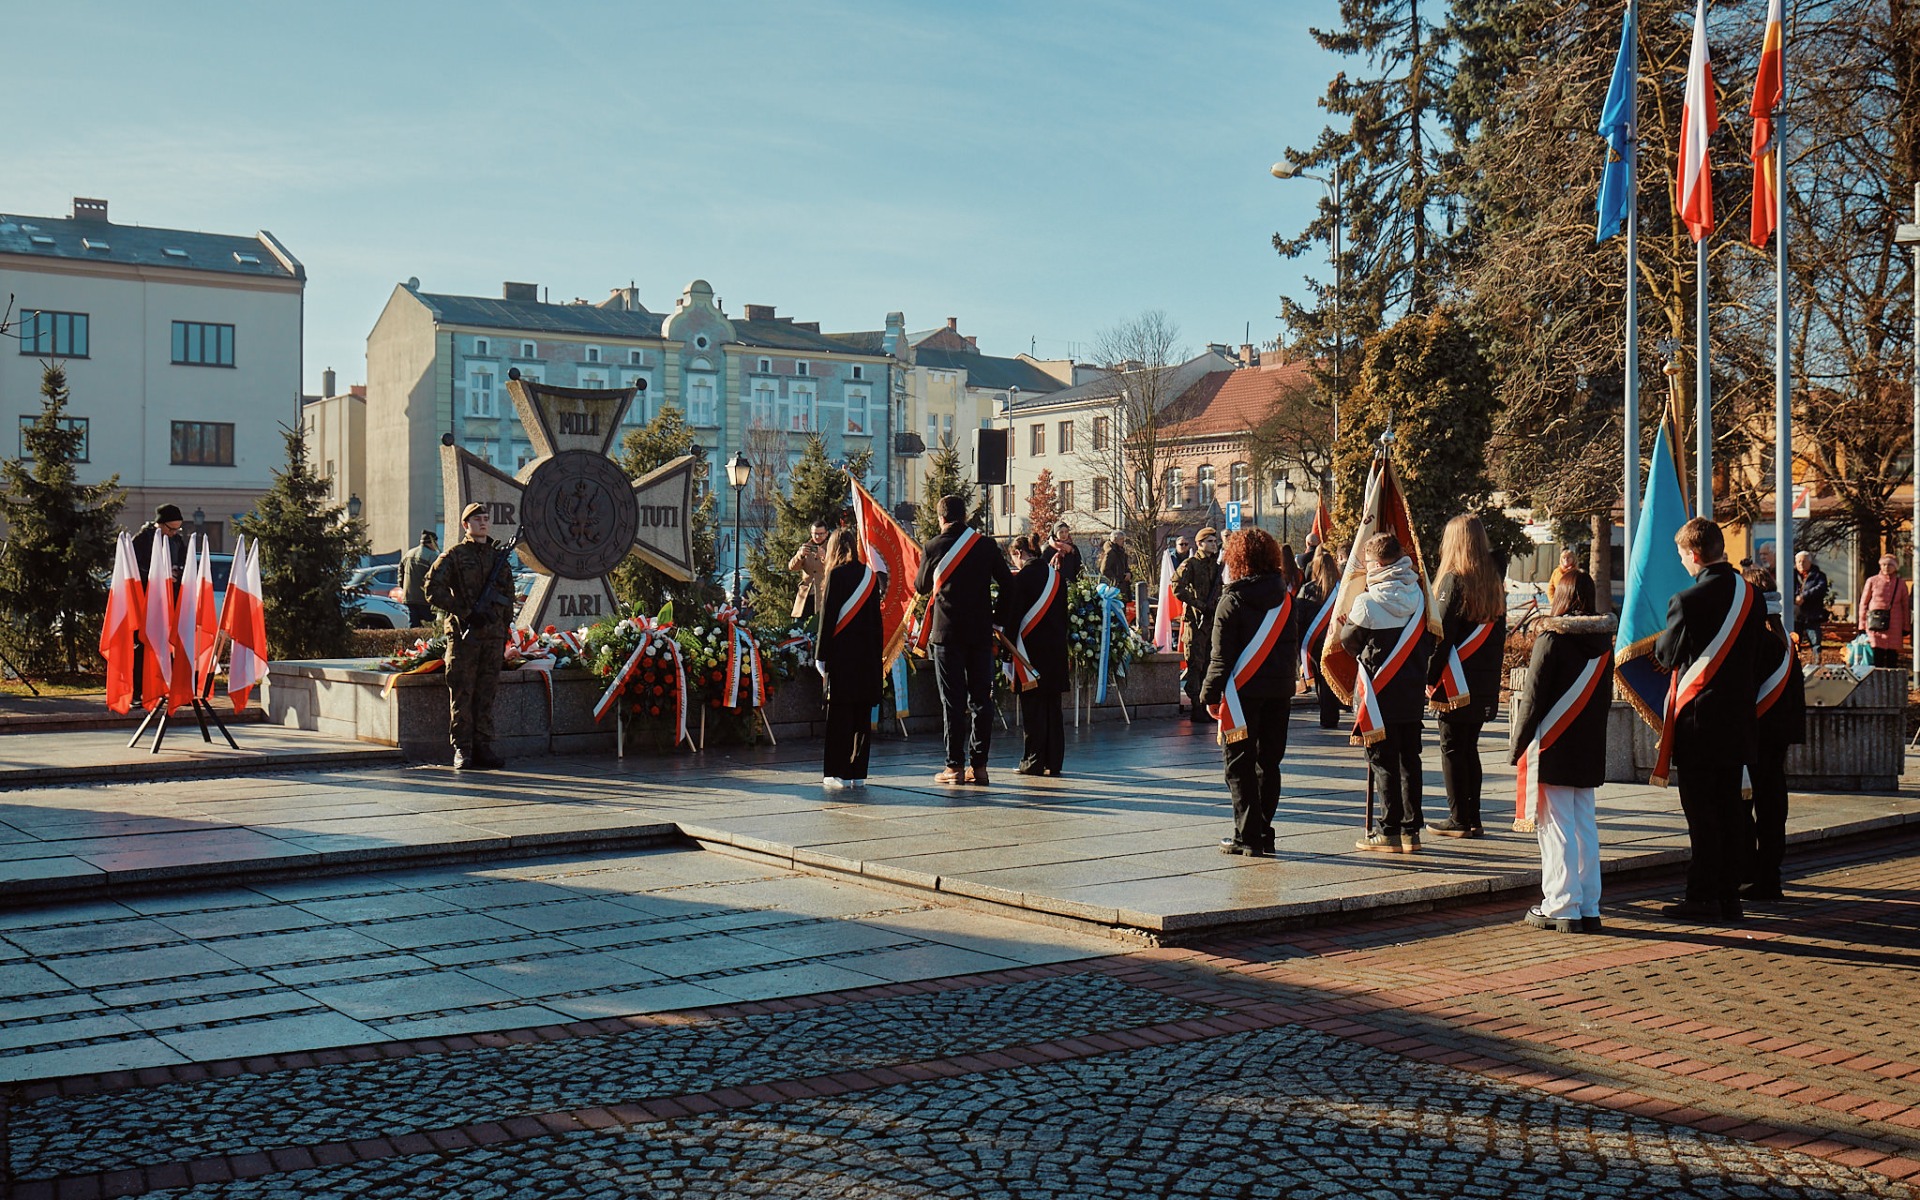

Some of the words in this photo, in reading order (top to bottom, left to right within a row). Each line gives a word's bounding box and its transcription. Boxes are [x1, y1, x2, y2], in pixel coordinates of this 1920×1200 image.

[559, 412, 600, 436] MILI
[641, 505, 679, 528] TUTI
[1229, 504, 1238, 523] P
[557, 594, 601, 617] TARI
